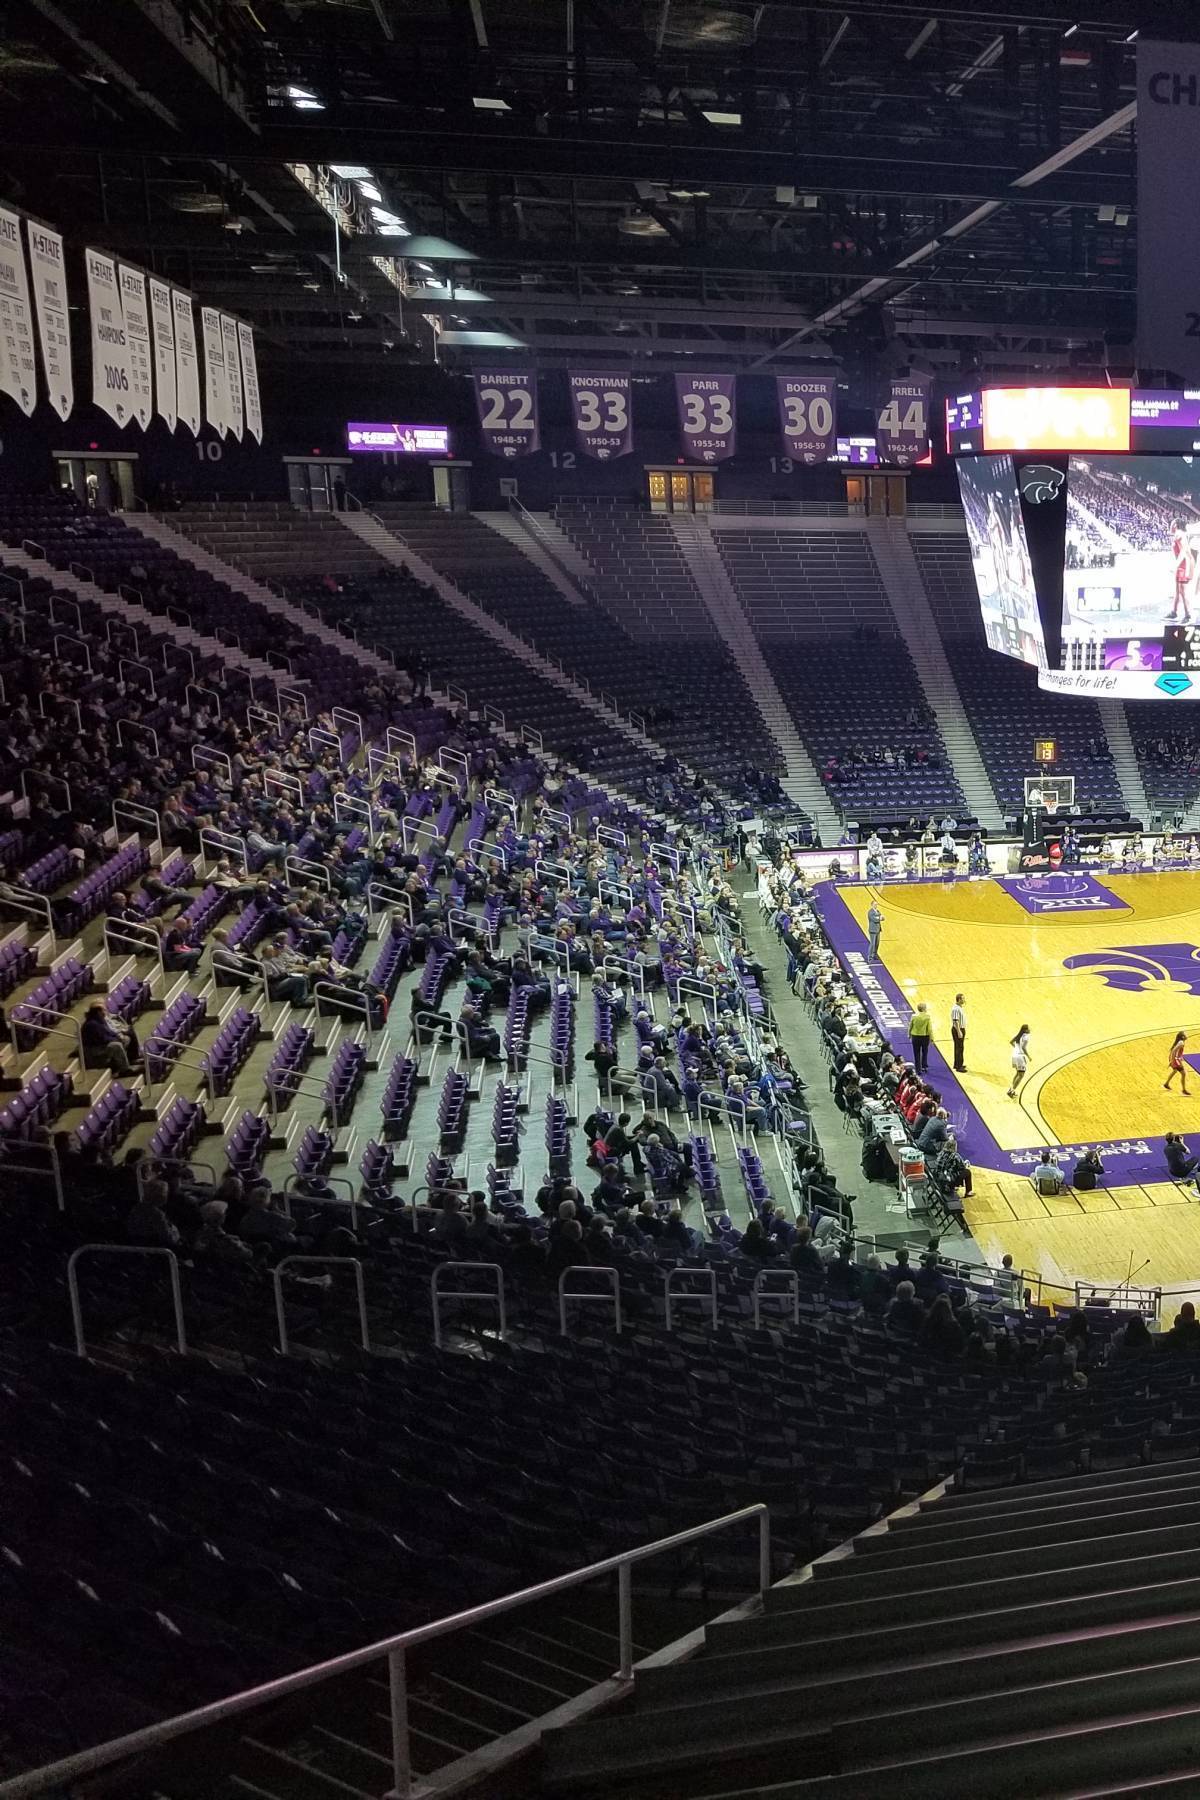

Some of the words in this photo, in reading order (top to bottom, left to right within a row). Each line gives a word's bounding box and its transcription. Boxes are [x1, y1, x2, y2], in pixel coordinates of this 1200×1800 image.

[104, 364, 129, 391] 2006
[480, 374, 529, 385] BARRETT
[571, 377, 629, 388] KNOSTMAN
[692, 381, 719, 390] PARR
[786, 384, 827, 393] BOOZER
[480, 389, 535, 429] 22
[576, 391, 628, 432] 33
[682, 394, 733, 434] 33
[783, 397, 833, 436] 30
[878, 400, 927, 438] 44
[492, 435, 527, 444] 1948-51
[586, 437, 621, 446] 1950-53
[692, 440, 726, 448] 1955-58
[793, 442, 826, 450] 1956-59
[196, 442, 222, 461] 10
[860, 447, 869, 460] 5
[887, 444, 919, 452] 1962-64
[551, 451, 576, 468] 12
[770, 456, 794, 473] 13
[1076, 675, 1091, 688] for
[1094, 676, 1117, 689] life!
